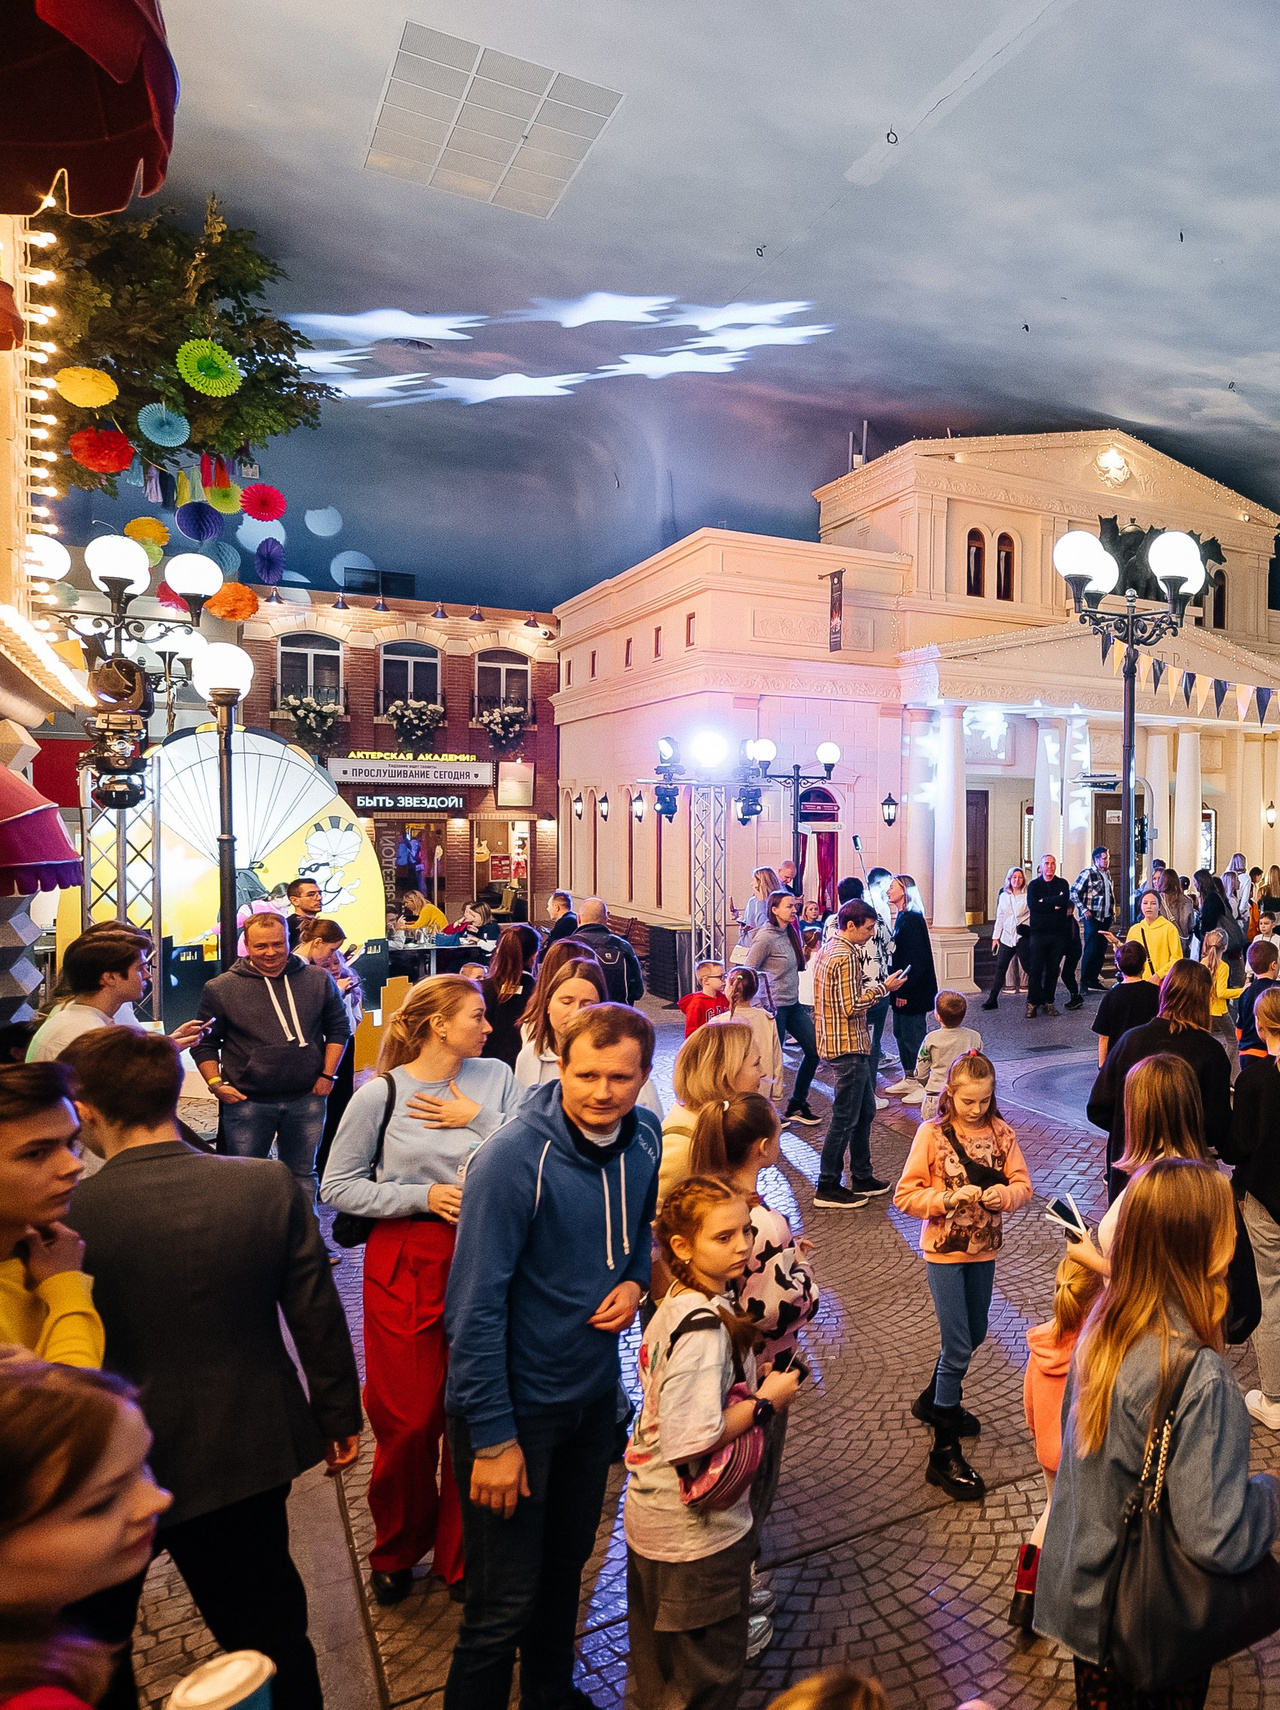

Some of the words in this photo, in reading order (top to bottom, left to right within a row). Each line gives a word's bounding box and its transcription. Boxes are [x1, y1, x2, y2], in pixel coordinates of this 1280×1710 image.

[347, 751, 413, 761] АКТЕРСКАЯ
[417, 753, 477, 762] АКАДЕМИЯ
[351, 768, 430, 779] ПРОСЛУШИВАНИЕ
[433, 770, 471, 780] СЕГОДНЯ
[356, 796, 394, 807] БЫТЬ
[396, 795, 463, 809] ЗВЕЗДОЙ!
